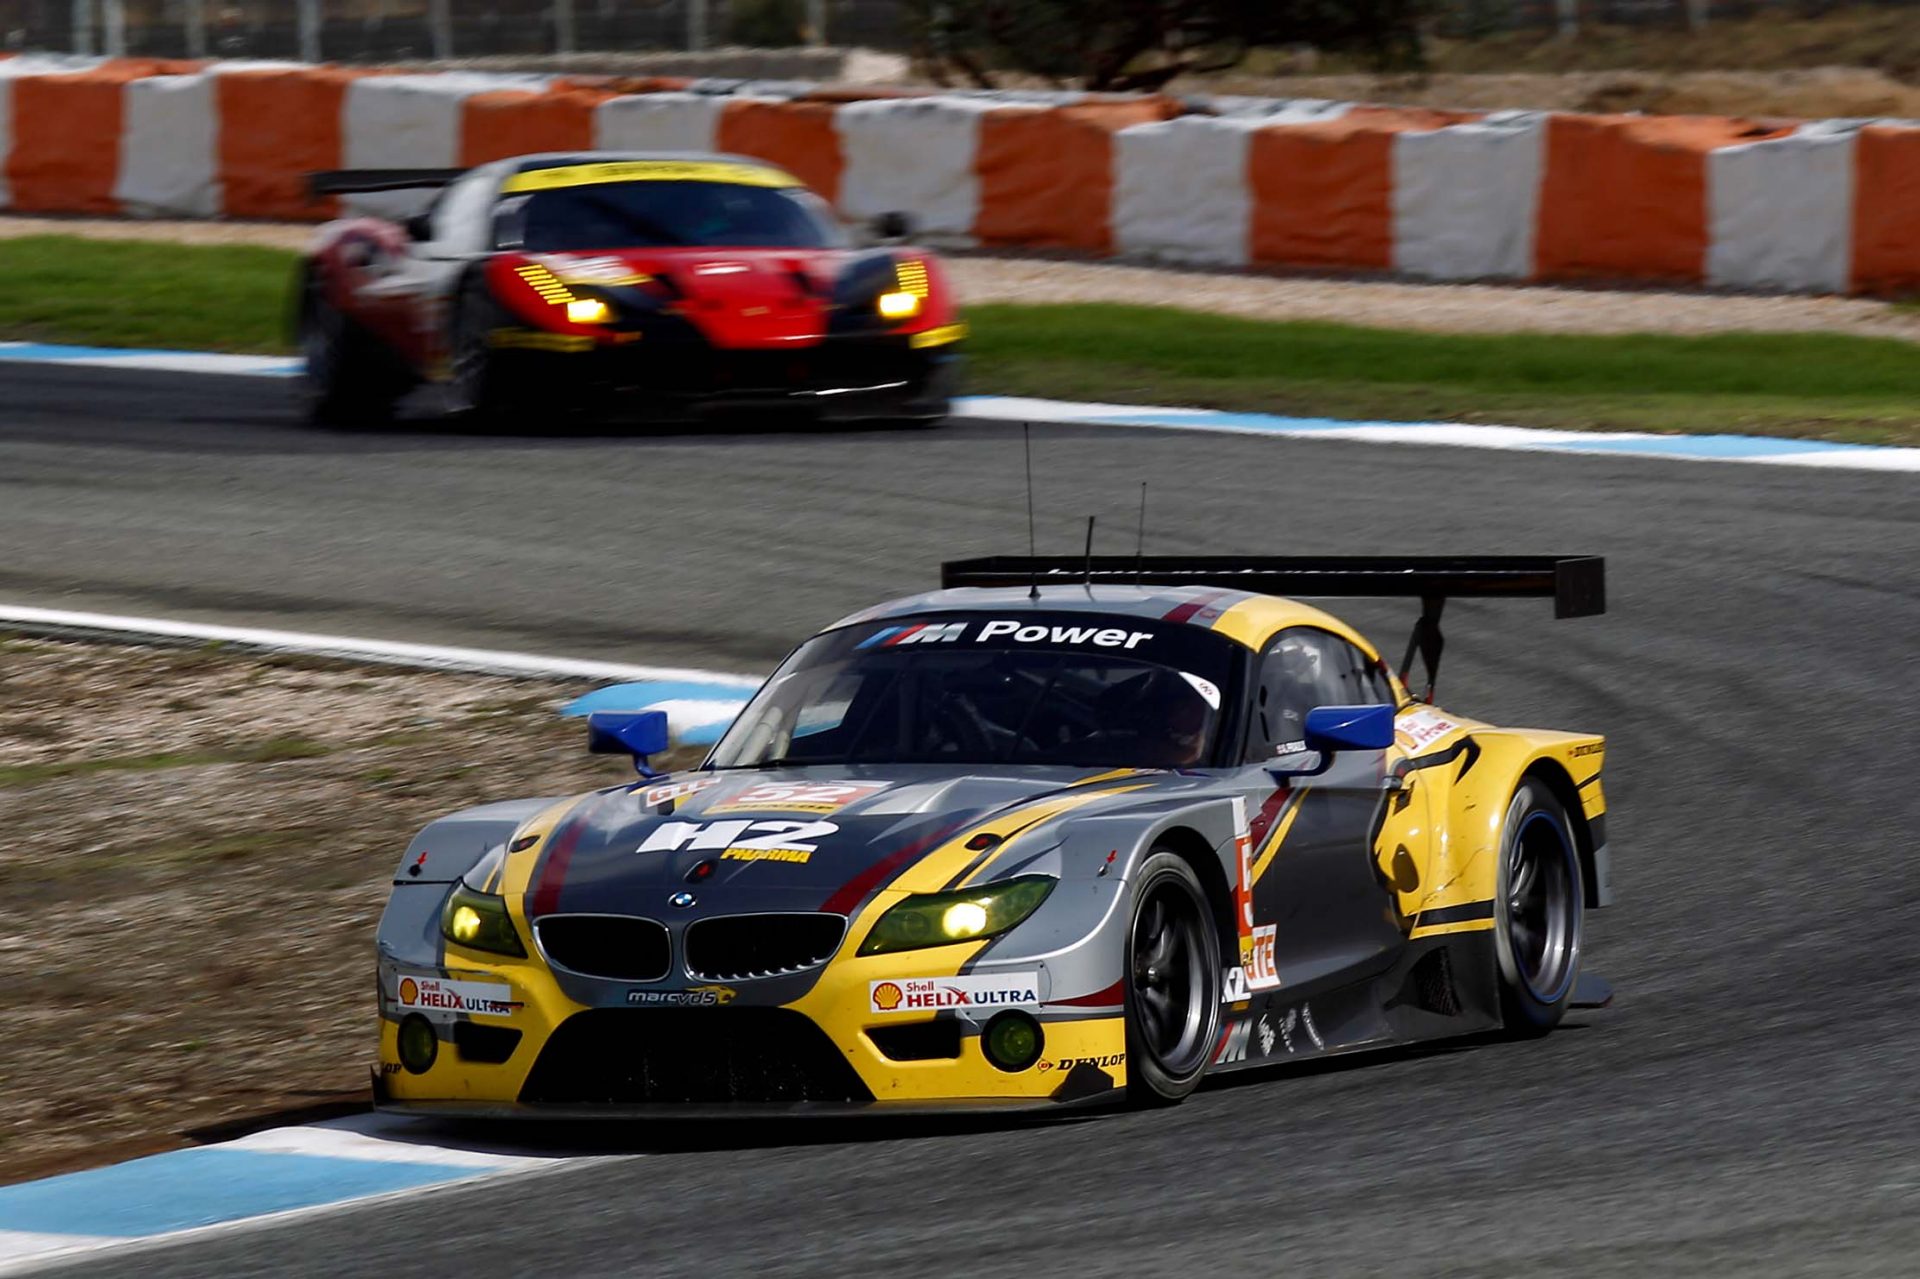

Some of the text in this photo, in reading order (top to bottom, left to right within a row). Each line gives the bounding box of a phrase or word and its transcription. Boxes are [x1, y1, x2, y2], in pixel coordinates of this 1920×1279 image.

[975, 620, 1154, 649] Power
[738, 786, 858, 803] 52
[635, 819, 841, 854] H2
[719, 847, 814, 864] PHARMA
[420, 980, 441, 991] Shell
[906, 981, 934, 992] Shell
[421, 991, 510, 1014] HELIX ULTRA
[907, 988, 1038, 1007] HELIX ULTRA
